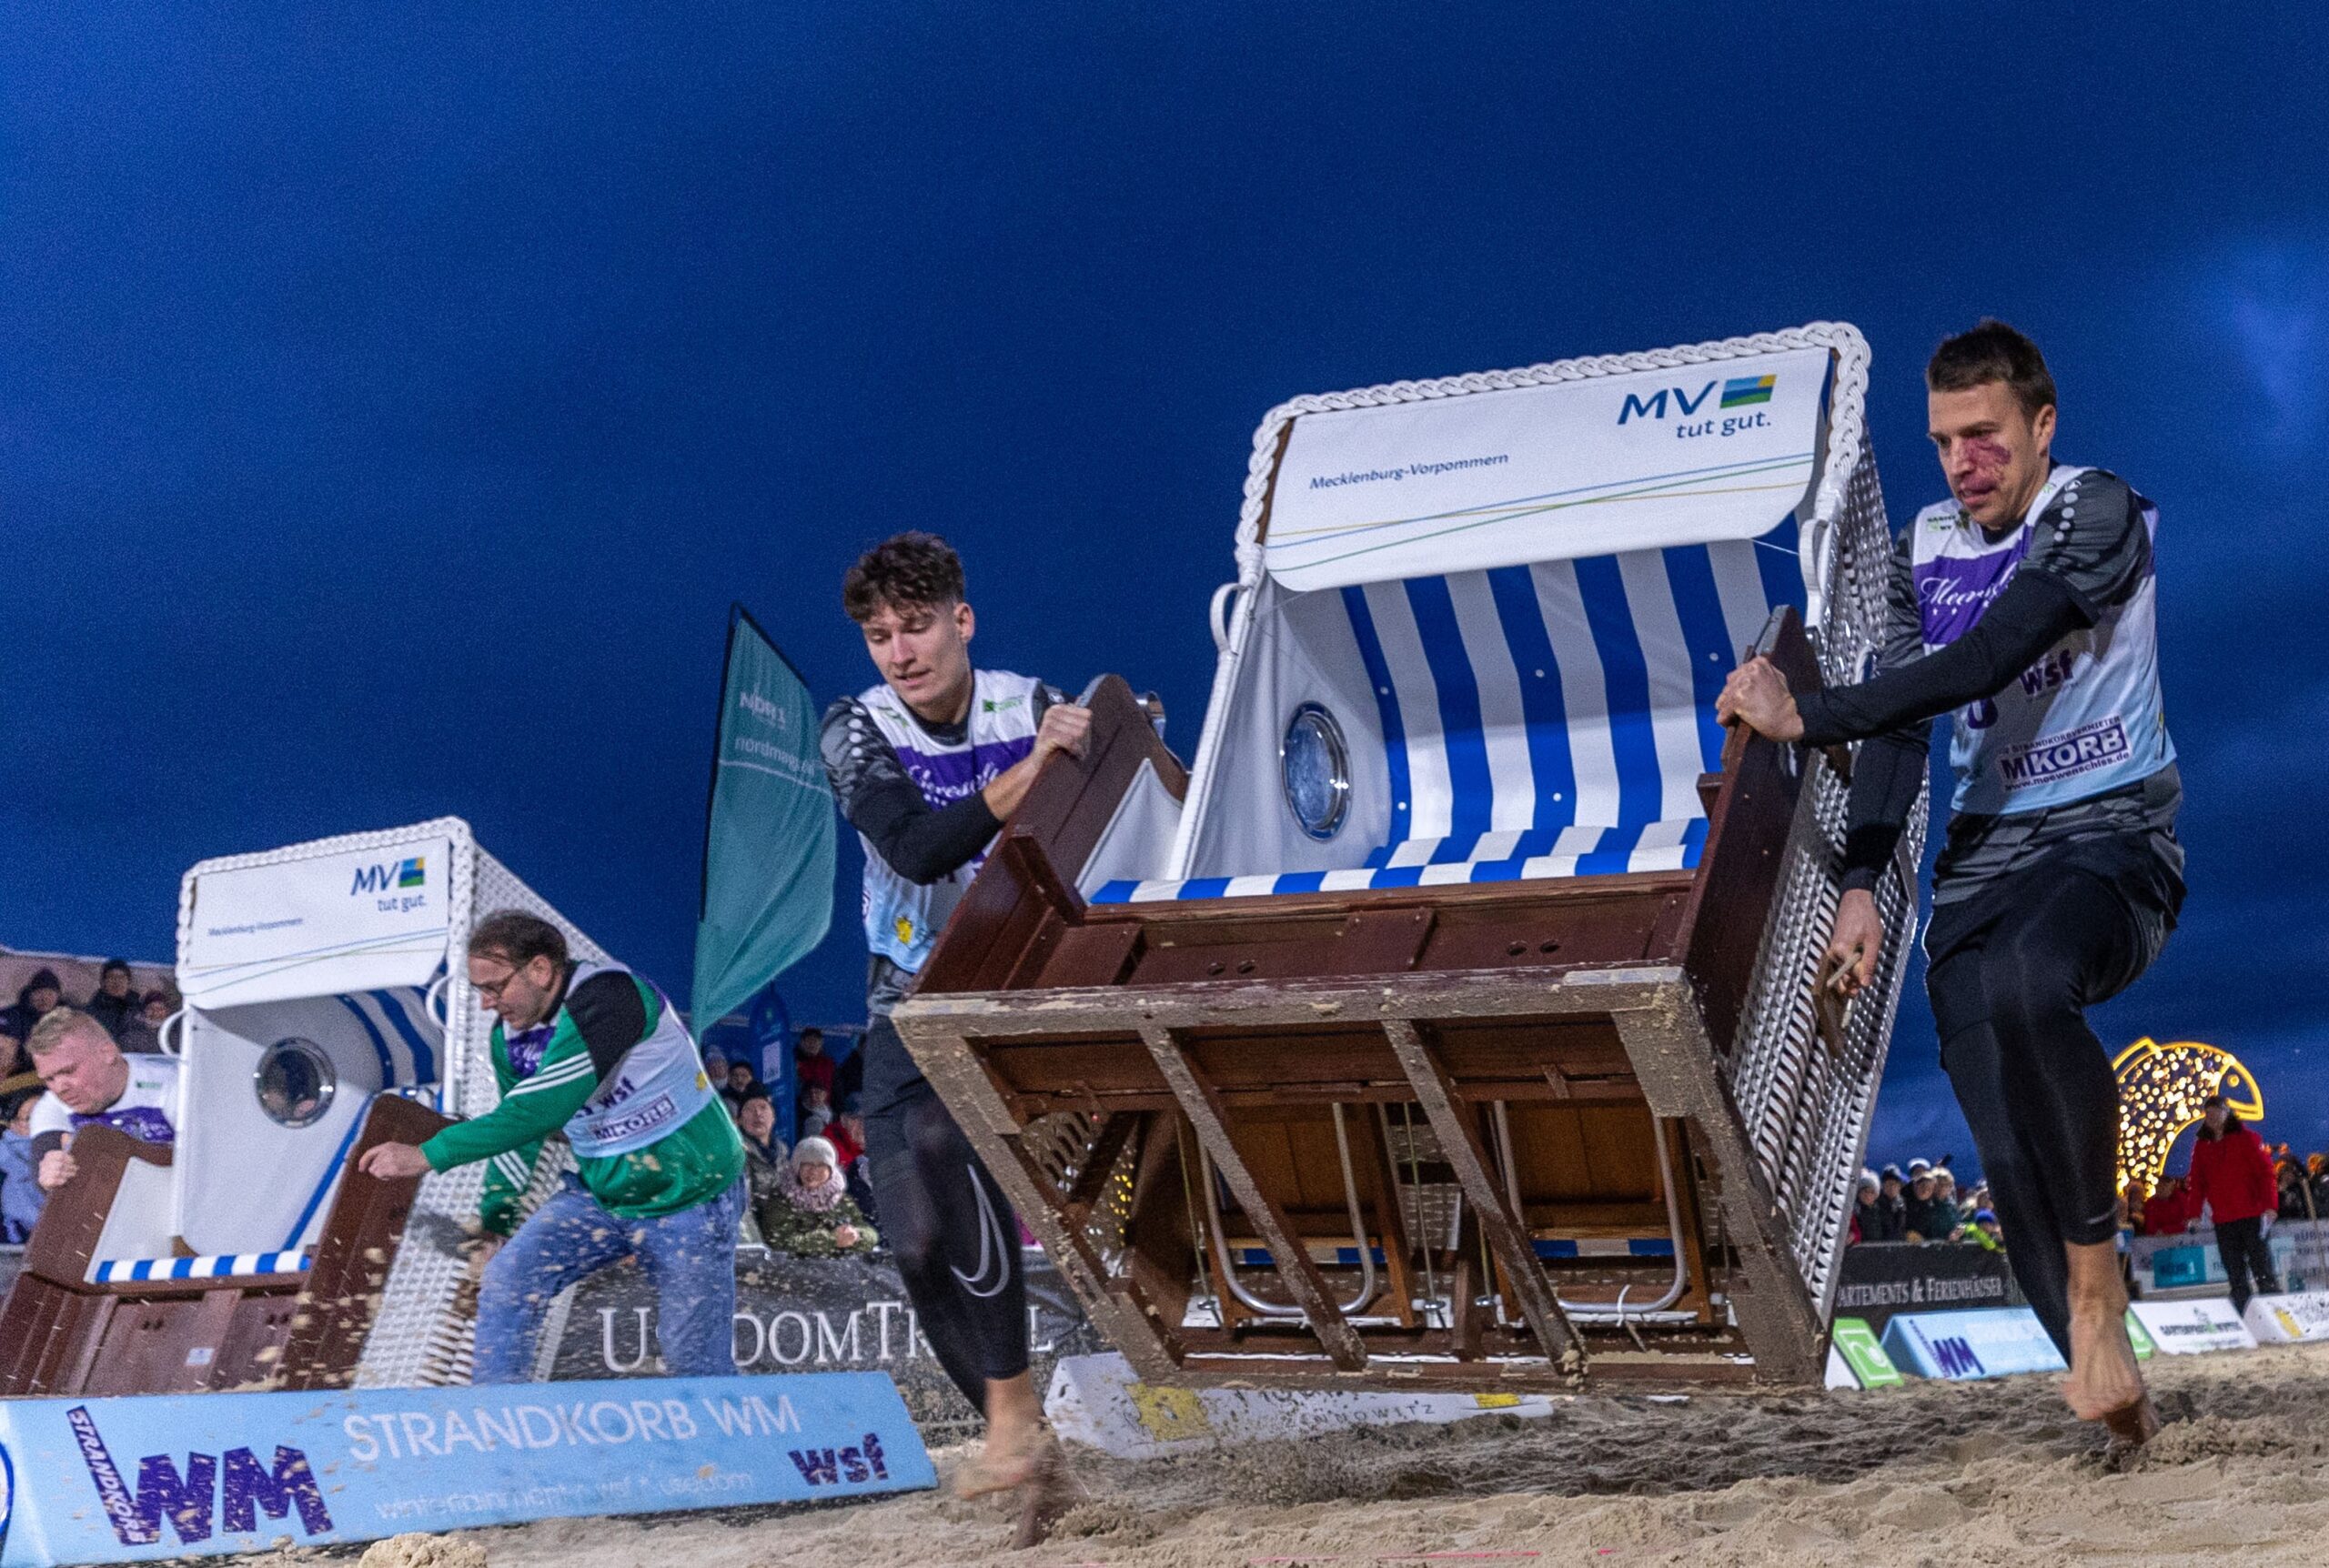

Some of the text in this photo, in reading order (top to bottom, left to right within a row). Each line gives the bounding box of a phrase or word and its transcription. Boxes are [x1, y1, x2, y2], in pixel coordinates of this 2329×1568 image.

[1618, 380, 1719, 425] MV
[1677, 411, 1772, 438] tut gut.
[1308, 454, 1509, 490] Mecklenburg-Vorpommern
[2019, 648, 2073, 695] wsf
[349, 860, 399, 896] MV
[377, 897, 398, 912] tut
[343, 1394, 802, 1462] STRANDKORB WM
[66, 1404, 334, 1545] WM
[69, 1409, 149, 1544] STRANDKORB
[787, 1432, 889, 1486] wsf
